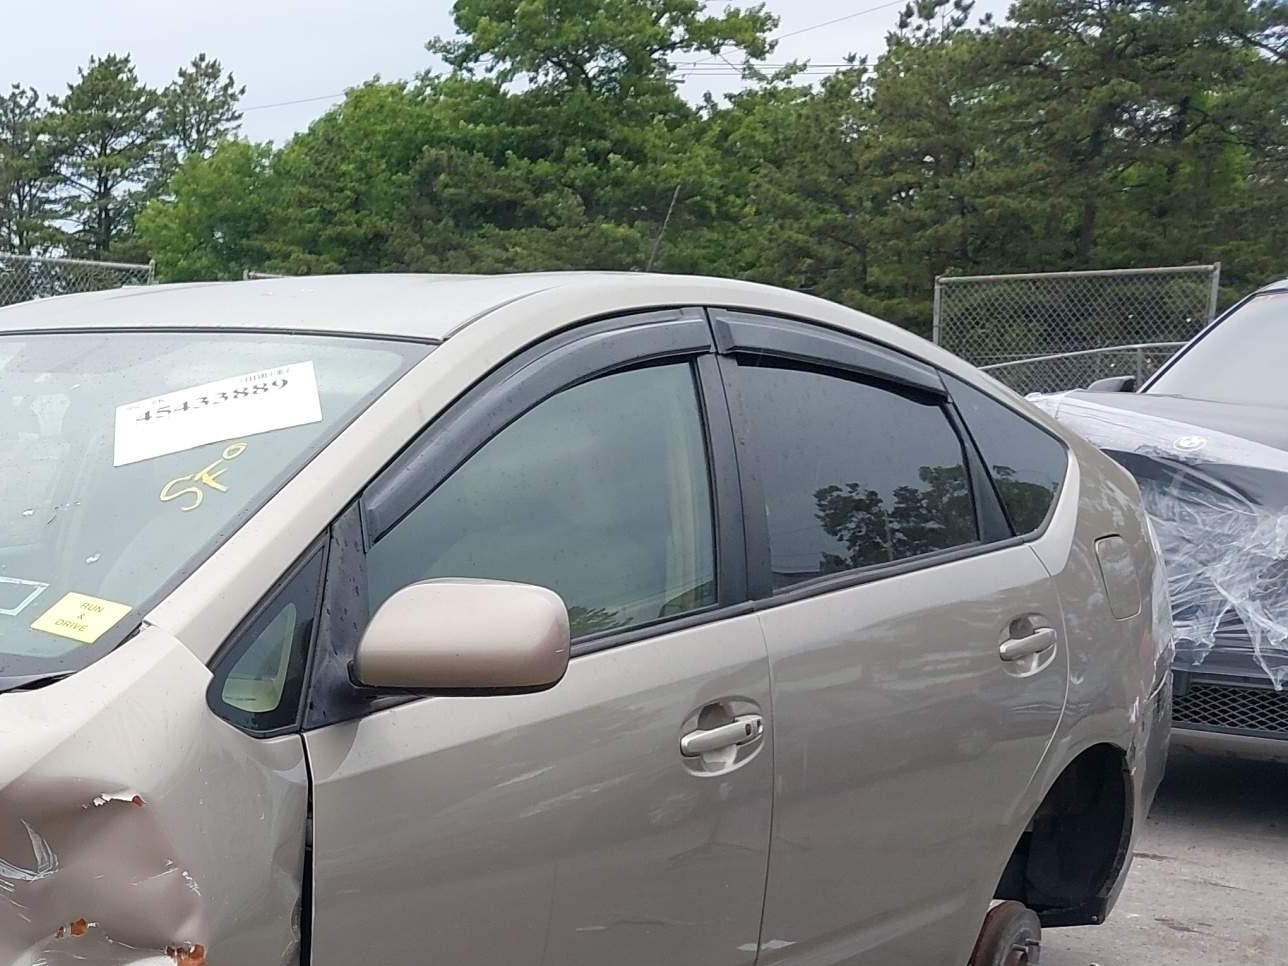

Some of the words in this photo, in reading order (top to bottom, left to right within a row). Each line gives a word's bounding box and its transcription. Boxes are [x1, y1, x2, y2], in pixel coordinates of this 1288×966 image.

[135, 378, 289, 423] 45433889
[79, 602, 105, 613] RUN
[54, 618, 89, 632] DRIVE
